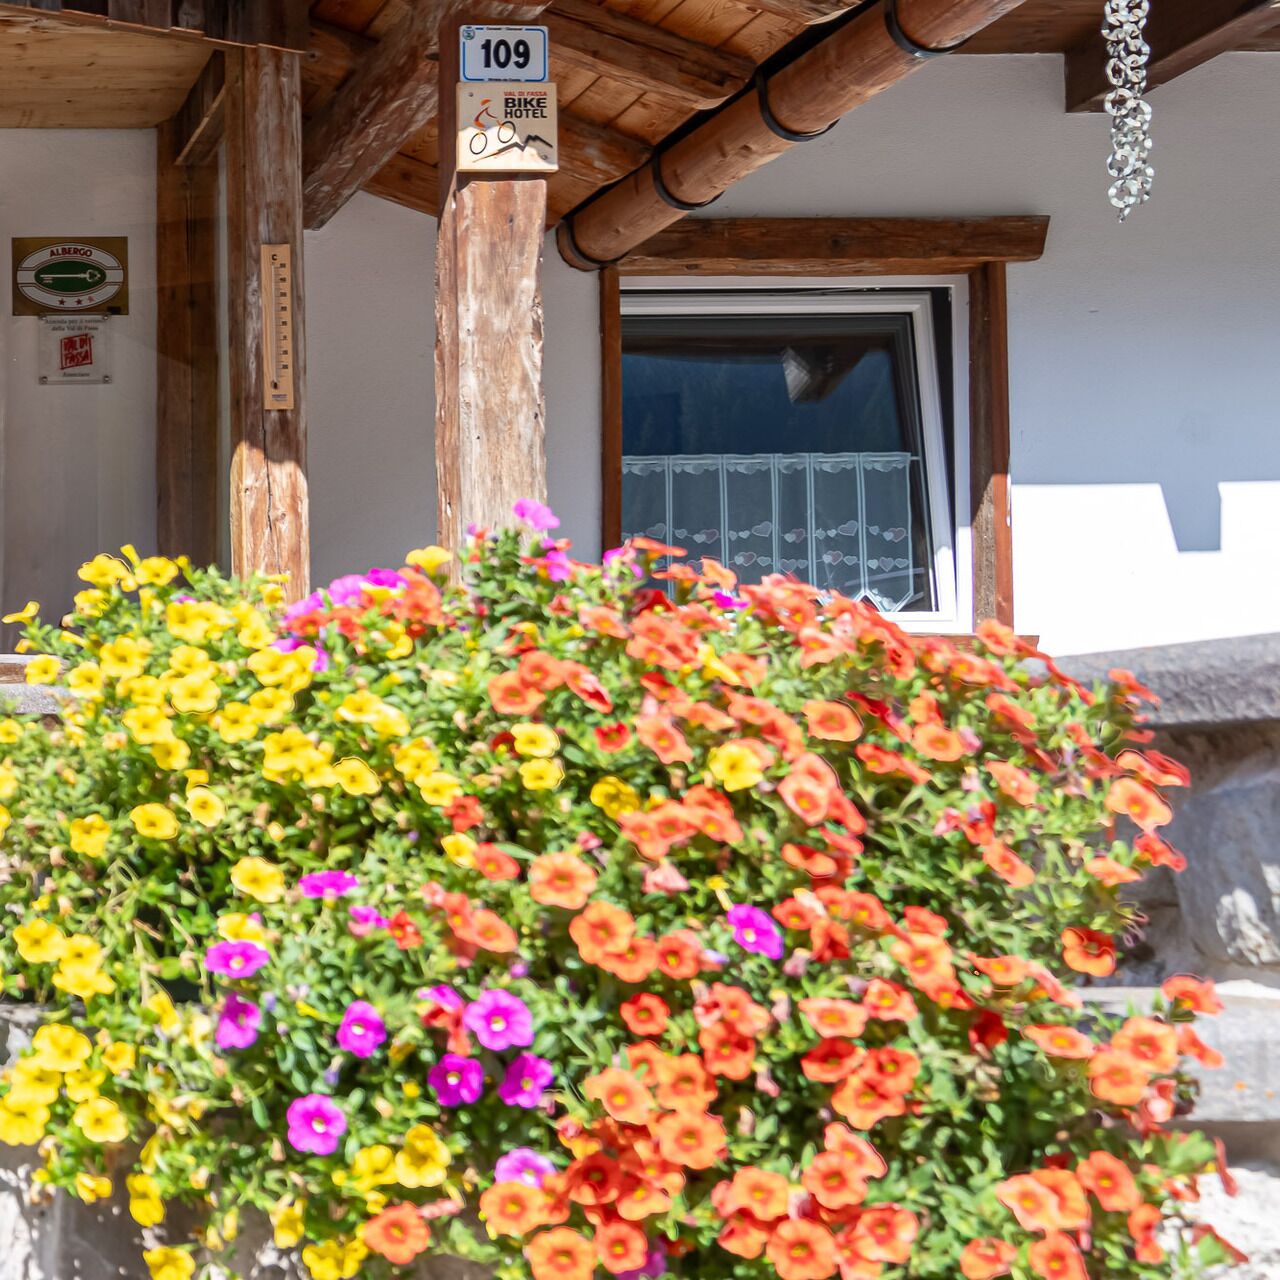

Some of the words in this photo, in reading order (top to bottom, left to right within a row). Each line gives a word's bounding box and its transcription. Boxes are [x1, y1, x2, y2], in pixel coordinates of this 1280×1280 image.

[481, 39, 530, 69] 109
[504, 97, 547, 108] BIKE
[504, 108, 548, 119] HOTEL
[49, 247, 93, 258] ALBERGO
[63, 337, 78, 352] VAL
[63, 349, 90, 366] FASSA
